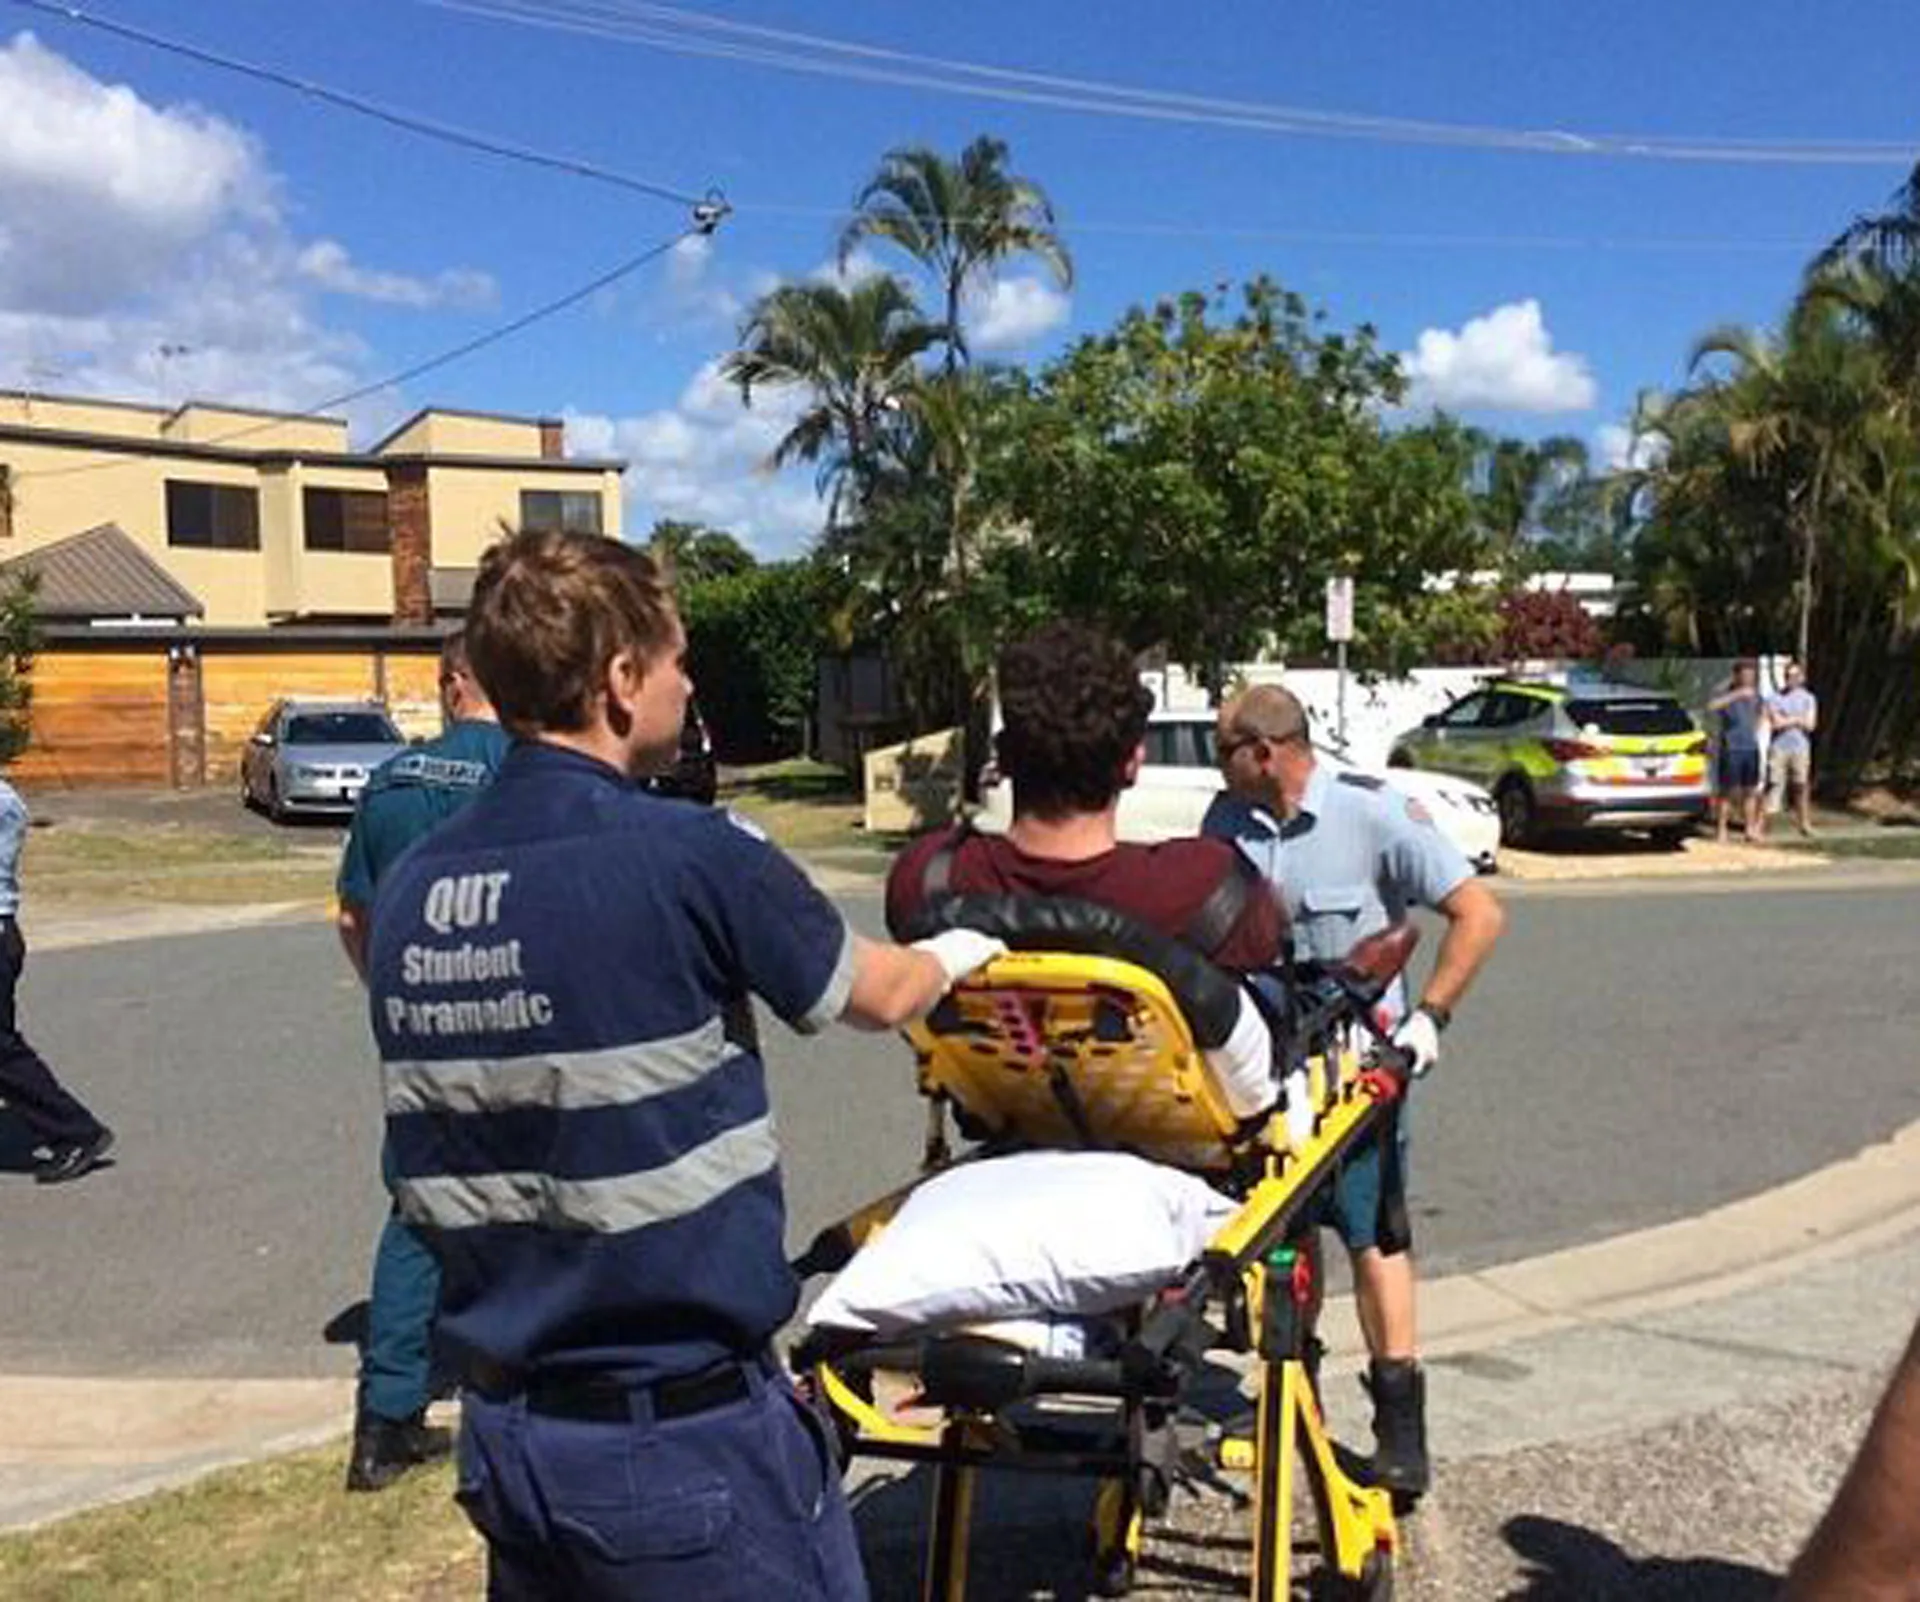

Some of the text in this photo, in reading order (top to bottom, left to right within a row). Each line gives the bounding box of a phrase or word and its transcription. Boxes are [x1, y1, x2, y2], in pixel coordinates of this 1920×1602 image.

[425, 872, 510, 933] QUT
[403, 940, 522, 985] Student
[385, 991, 553, 1035] Paramedic
